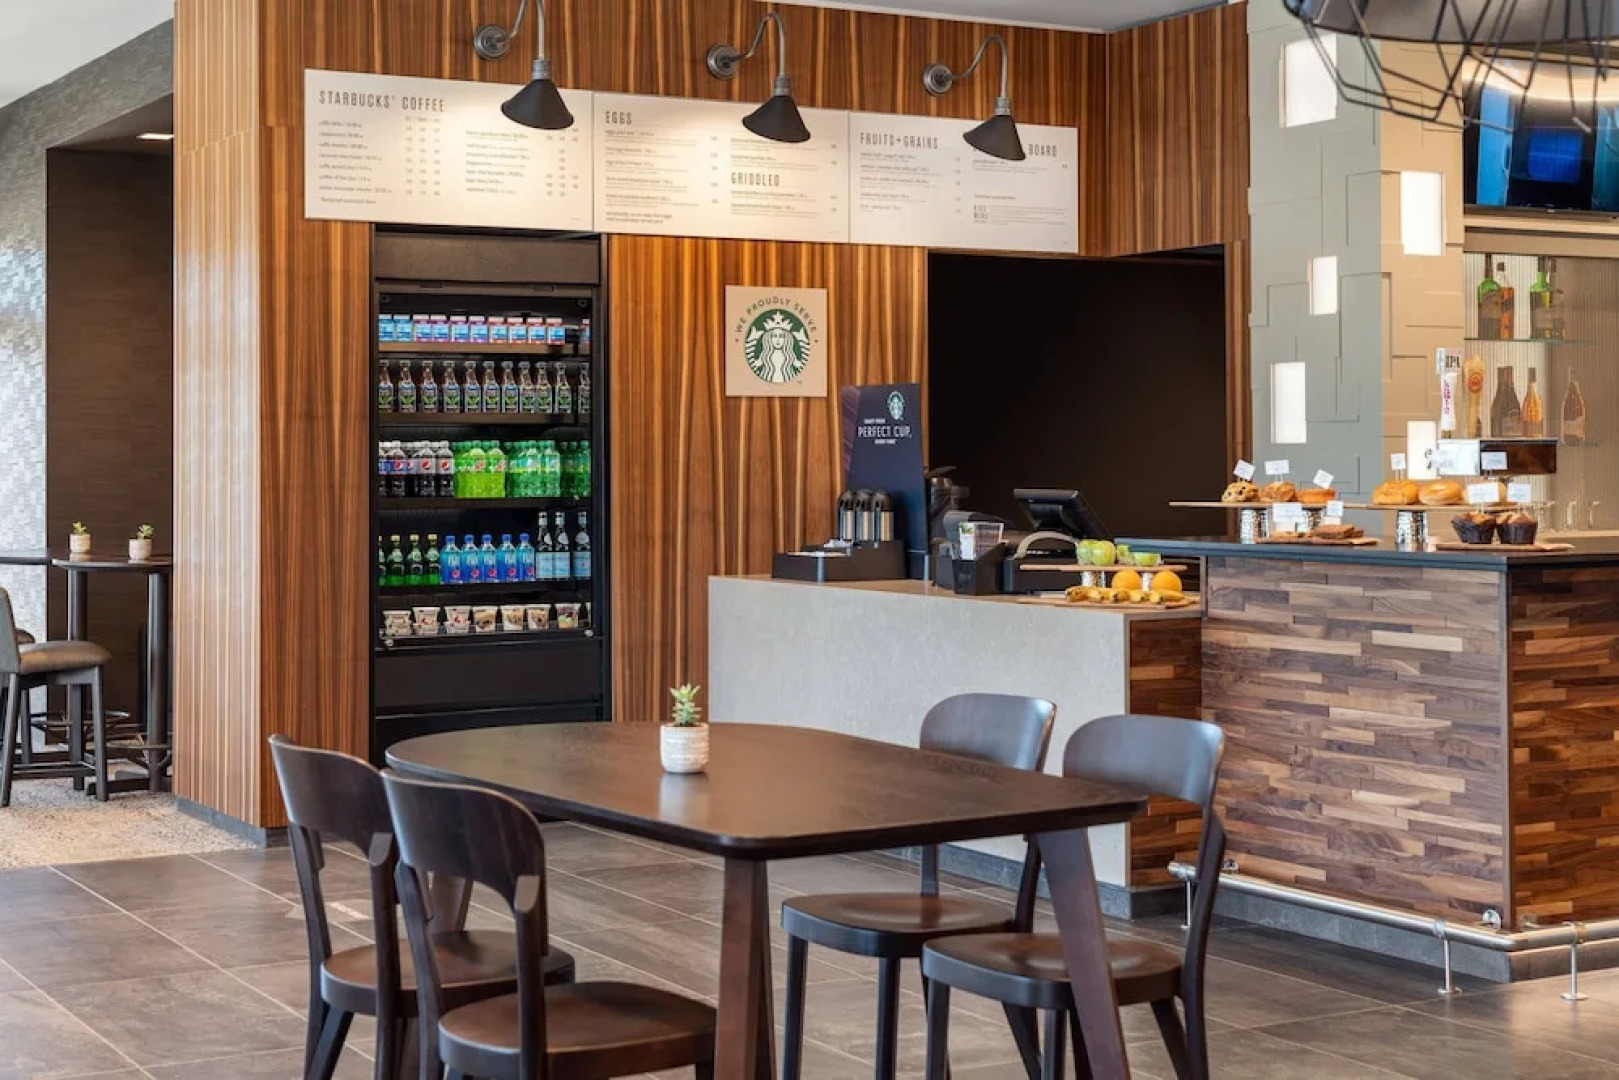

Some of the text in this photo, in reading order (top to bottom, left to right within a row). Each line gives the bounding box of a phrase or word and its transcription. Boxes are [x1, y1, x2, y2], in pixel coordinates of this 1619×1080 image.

[402, 96, 445, 112] COFFEE
[605, 110, 632, 125] EGGS
[1027, 143, 1057, 157] BOARD
[731, 171, 780, 187] GRIDDLED
[735, 296, 817, 333] WE PROUDLY SERVE
[857, 425, 891, 438] PERFECT
